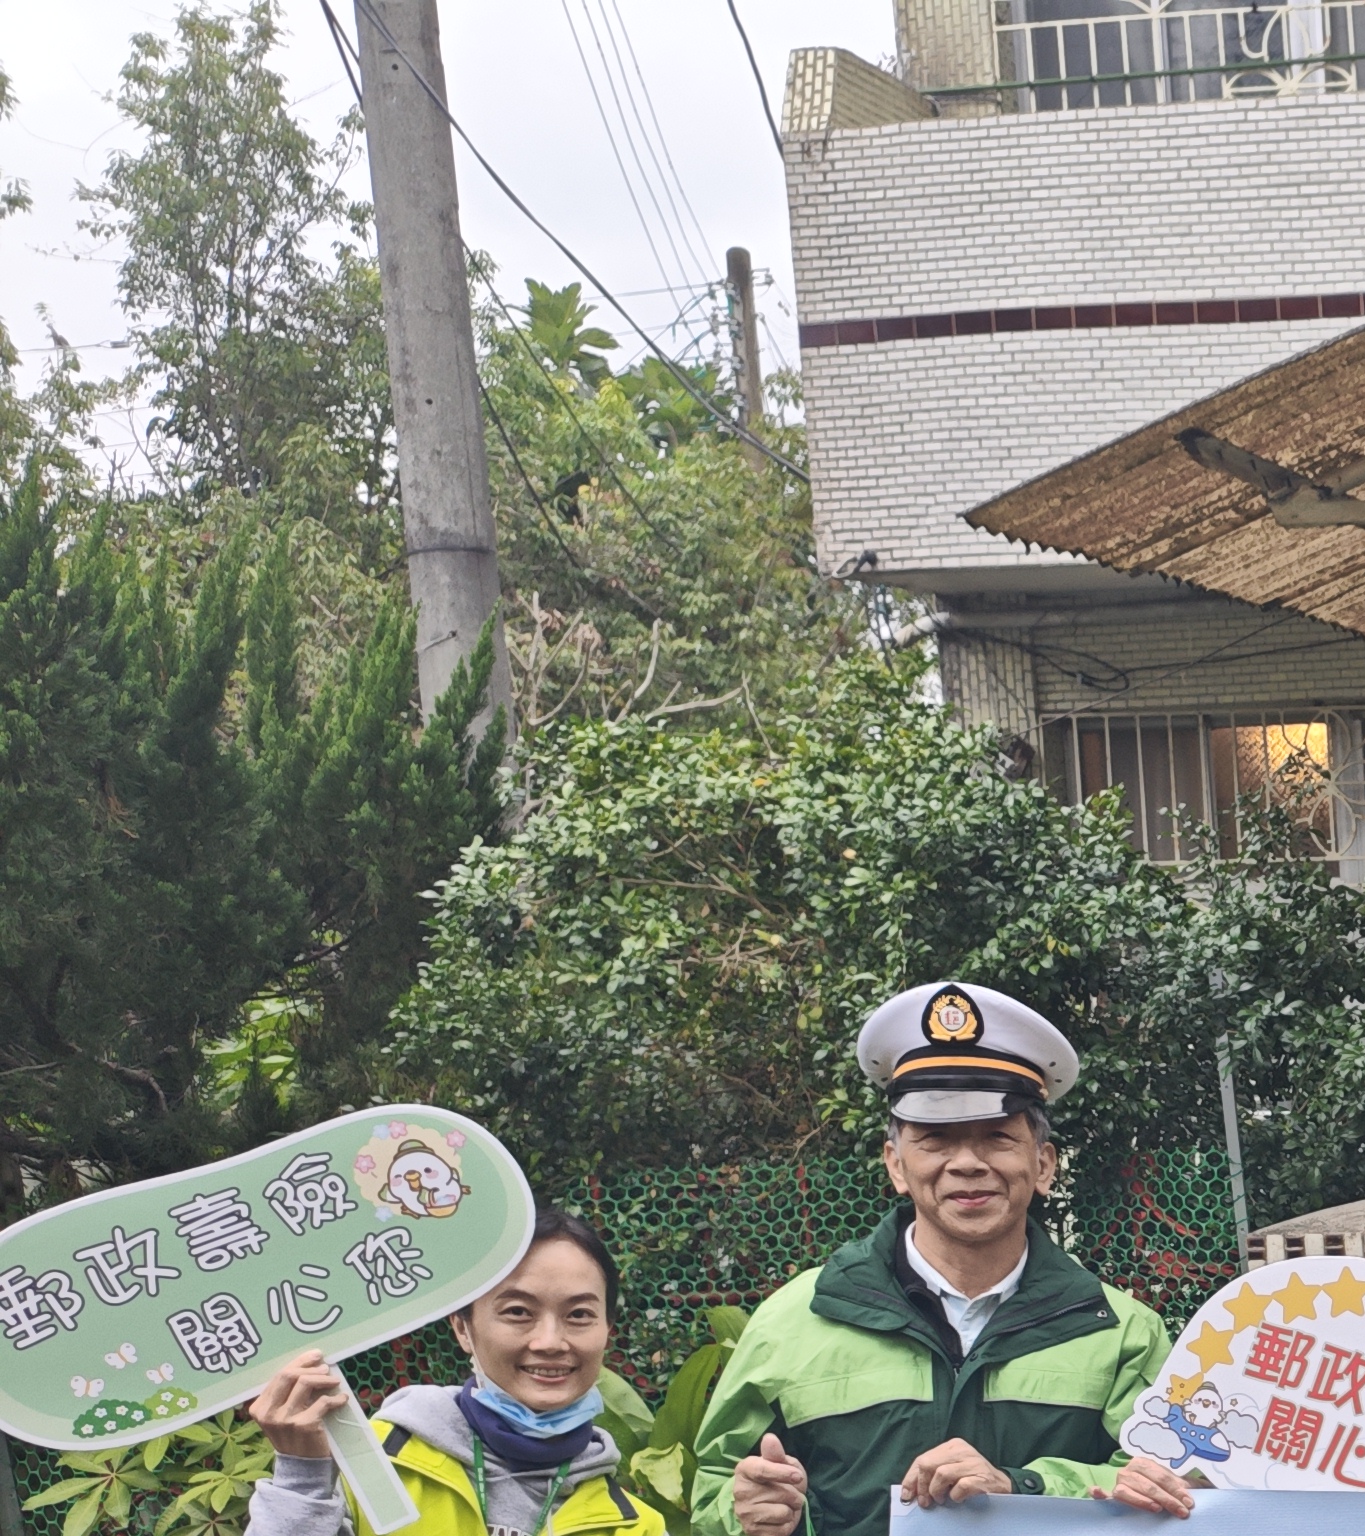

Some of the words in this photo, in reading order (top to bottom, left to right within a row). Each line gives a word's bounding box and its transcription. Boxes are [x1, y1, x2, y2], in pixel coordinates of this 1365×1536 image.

[0, 1152, 357, 1350] 郵政壽險
[166, 1226, 433, 1373] 關心您
